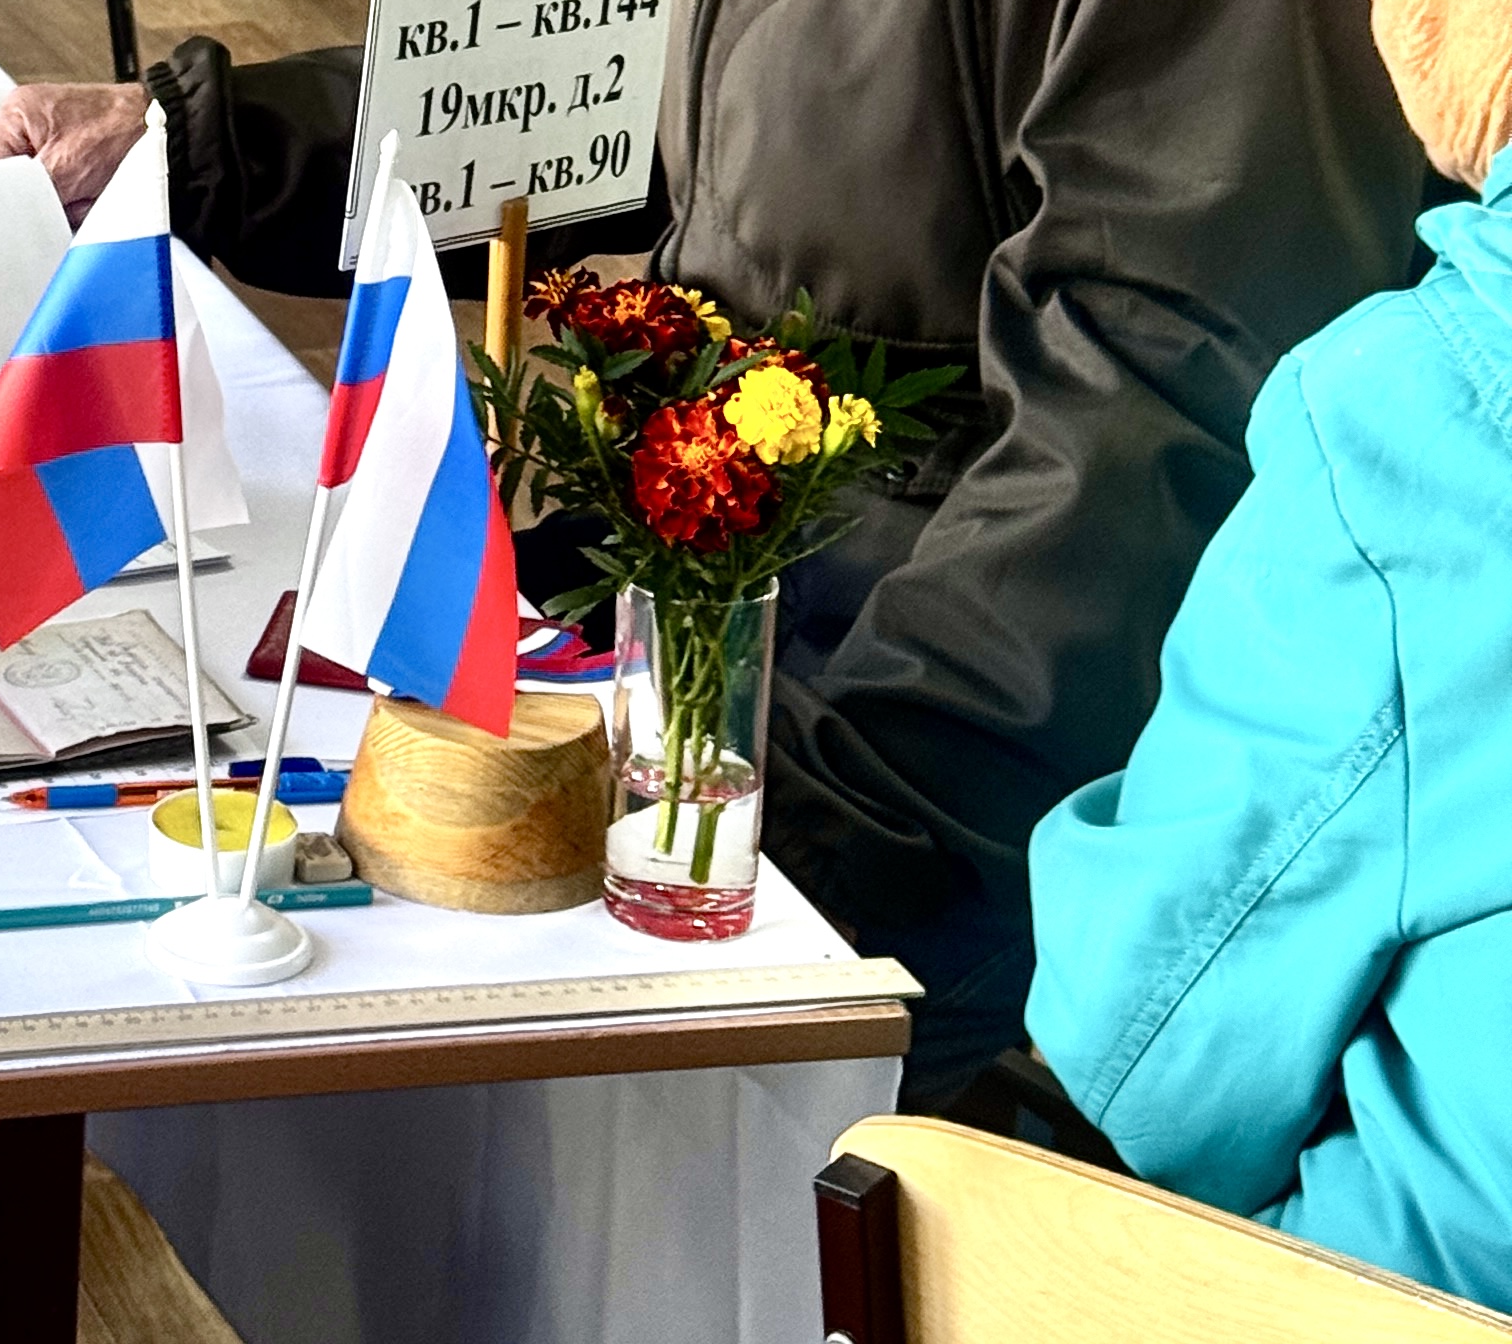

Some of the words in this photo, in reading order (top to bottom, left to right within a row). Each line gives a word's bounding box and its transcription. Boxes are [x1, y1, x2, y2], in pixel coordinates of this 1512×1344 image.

[394, 0, 482, 61] кв.1
[415, 82, 558, 139] 19мкр.
[565, 53, 626, 118] д.2
[411, 158, 476, 217] в.1
[526, 129, 632, 196] кв.90
